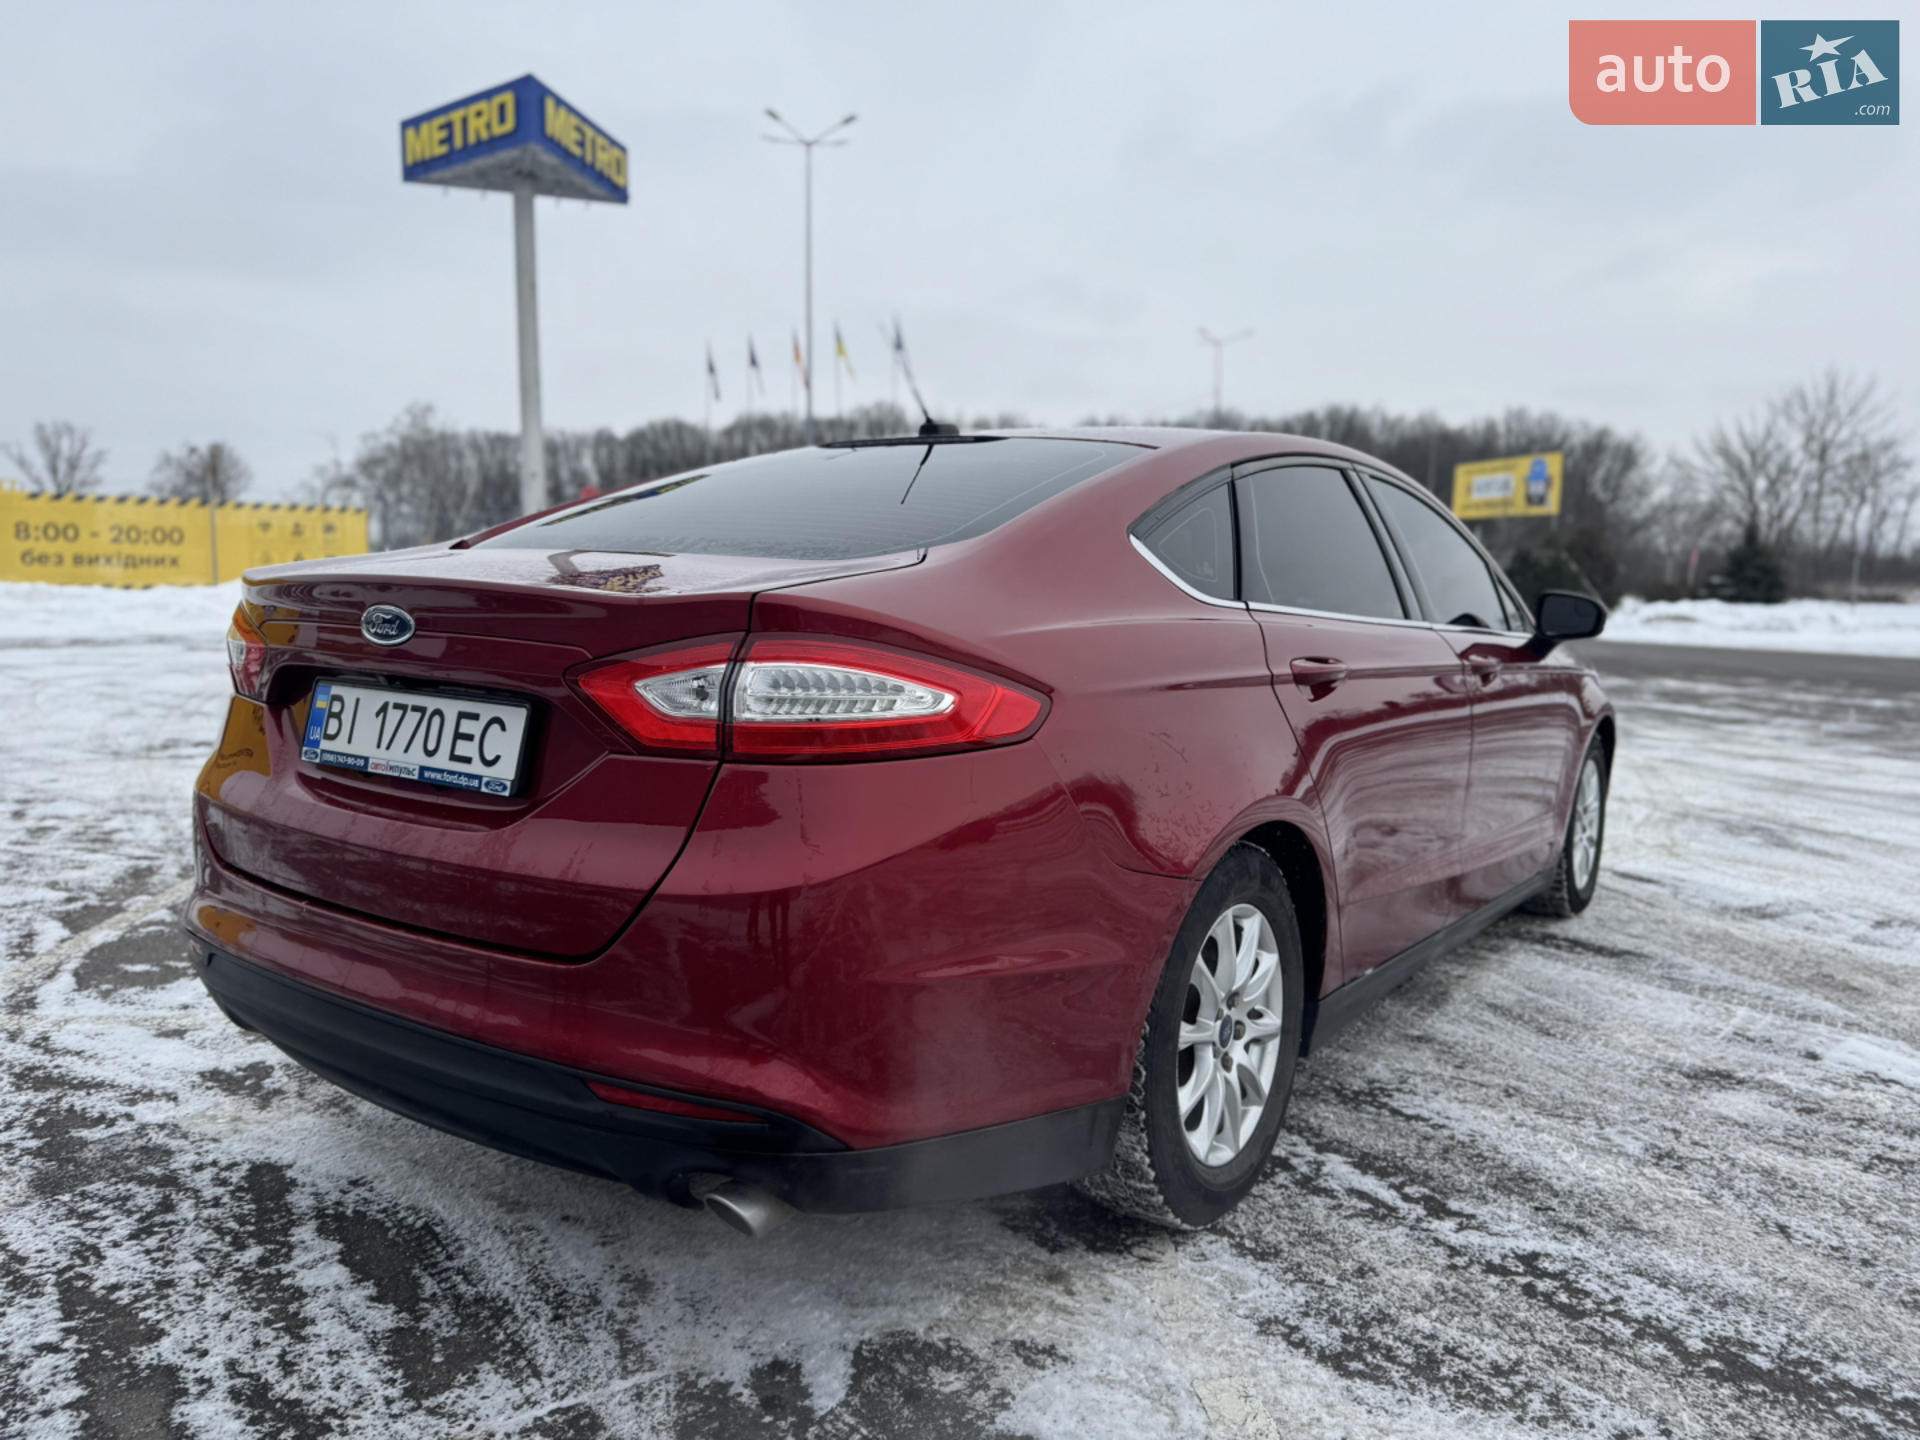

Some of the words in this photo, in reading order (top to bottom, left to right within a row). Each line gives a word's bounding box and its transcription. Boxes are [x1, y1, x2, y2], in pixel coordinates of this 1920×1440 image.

[405, 90, 516, 166] METRO
[544, 94, 627, 189] METRO
[14, 520, 80, 543] 8:00
[109, 524, 185, 546] 20:00
[20, 548, 64, 567] без
[73, 549, 180, 570] вихідних
[368, 612, 400, 636] Ford
[309, 725, 321, 741] UA
[322, 693, 361, 745] BI
[375, 700, 445, 758] 1770
[448, 709, 507, 768] EC
[423, 770, 479, 788] www.ford.dp.ua
